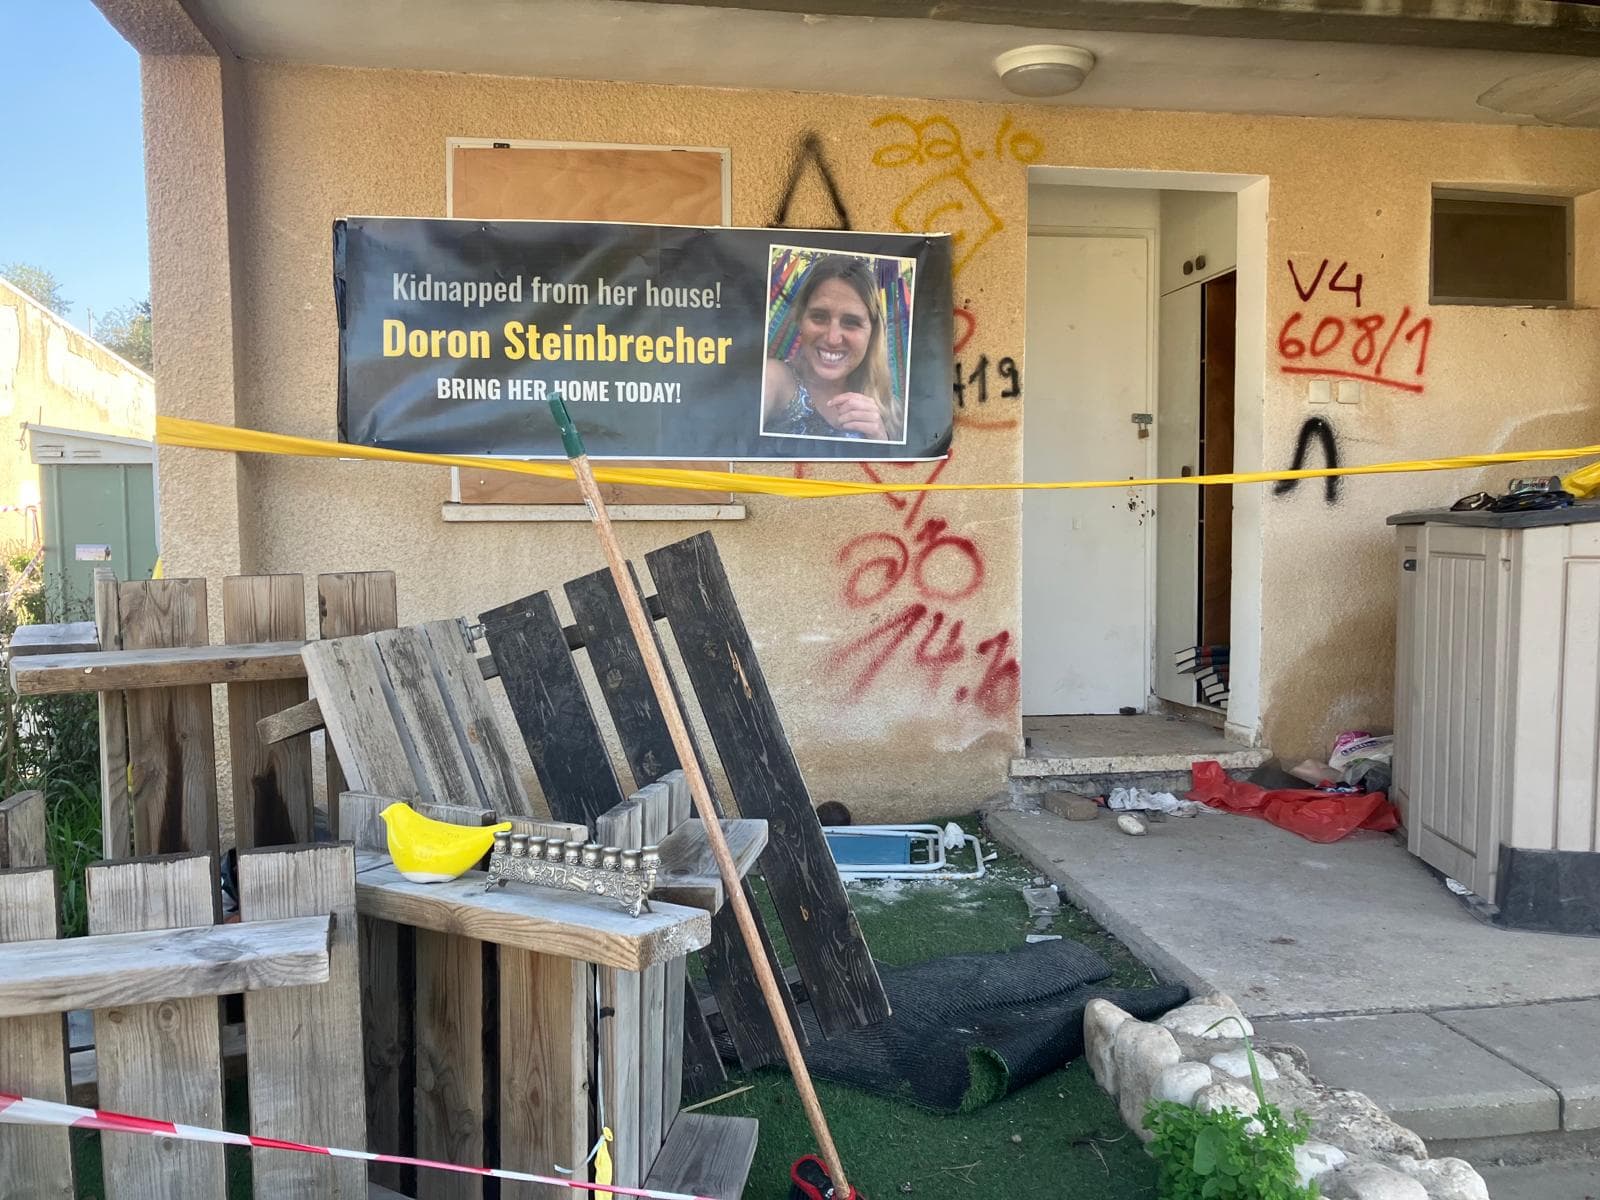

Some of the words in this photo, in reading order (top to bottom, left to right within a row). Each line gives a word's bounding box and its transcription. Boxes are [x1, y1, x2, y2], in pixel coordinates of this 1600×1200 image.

[392, 272, 522, 308] Kidnapped
[531, 275, 588, 304] from
[598, 278, 637, 307] her
[646, 280, 722, 309] house!
[1287, 259, 1363, 307] V4
[382, 319, 491, 359] Doron
[503, 320, 733, 364] Steinbrecher
[1278, 305, 1432, 376] 608/1
[437, 378, 501, 400] BRING
[508, 379, 547, 400] HER
[554, 380, 609, 402] HOME
[615, 381, 682, 403] TODAY!
